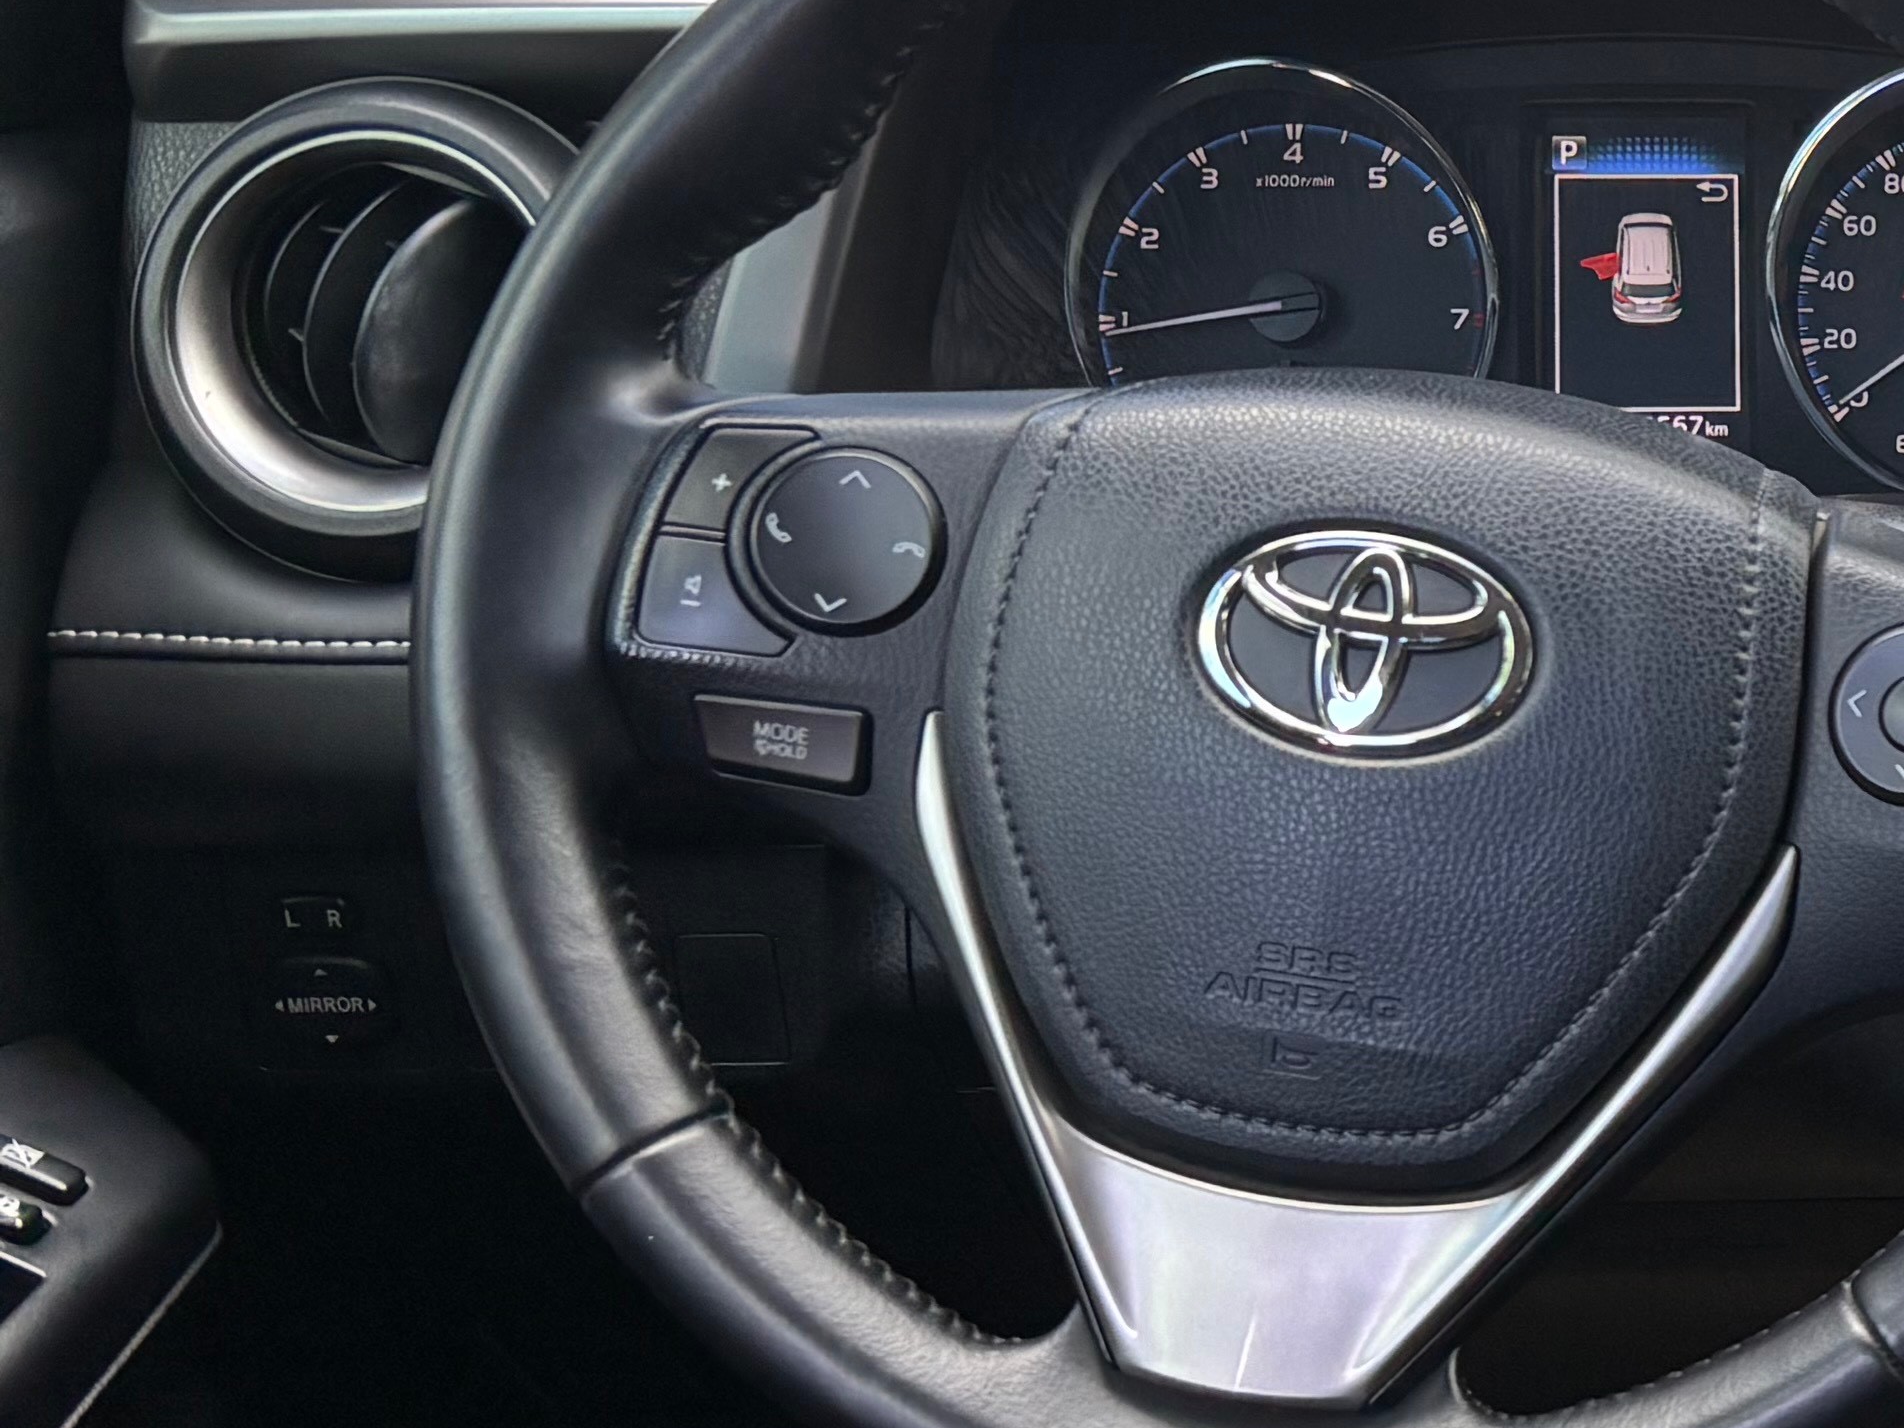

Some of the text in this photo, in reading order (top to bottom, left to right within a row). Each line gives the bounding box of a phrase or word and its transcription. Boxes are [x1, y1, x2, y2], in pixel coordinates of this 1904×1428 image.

[1283, 143, 1304, 164] 4
[1560, 140, 1579, 166] P
[1200, 167, 1219, 189] 3
[1368, 167, 1387, 189] 5
[1428, 226, 1447, 248] 6
[1843, 215, 1877, 237] 60
[1140, 228, 1160, 249] 2
[1820, 270, 1854, 292] 40
[1122, 311, 1129, 327] 1
[1450, 308, 1470, 330] 7
[1823, 328, 1857, 349] 20
[753, 719, 810, 743] MODE
[285, 909, 300, 928] L
[326, 909, 342, 928] R
[288, 997, 364, 1014] MIRROR
[1203, 971, 1402, 1021] AIRBAG
